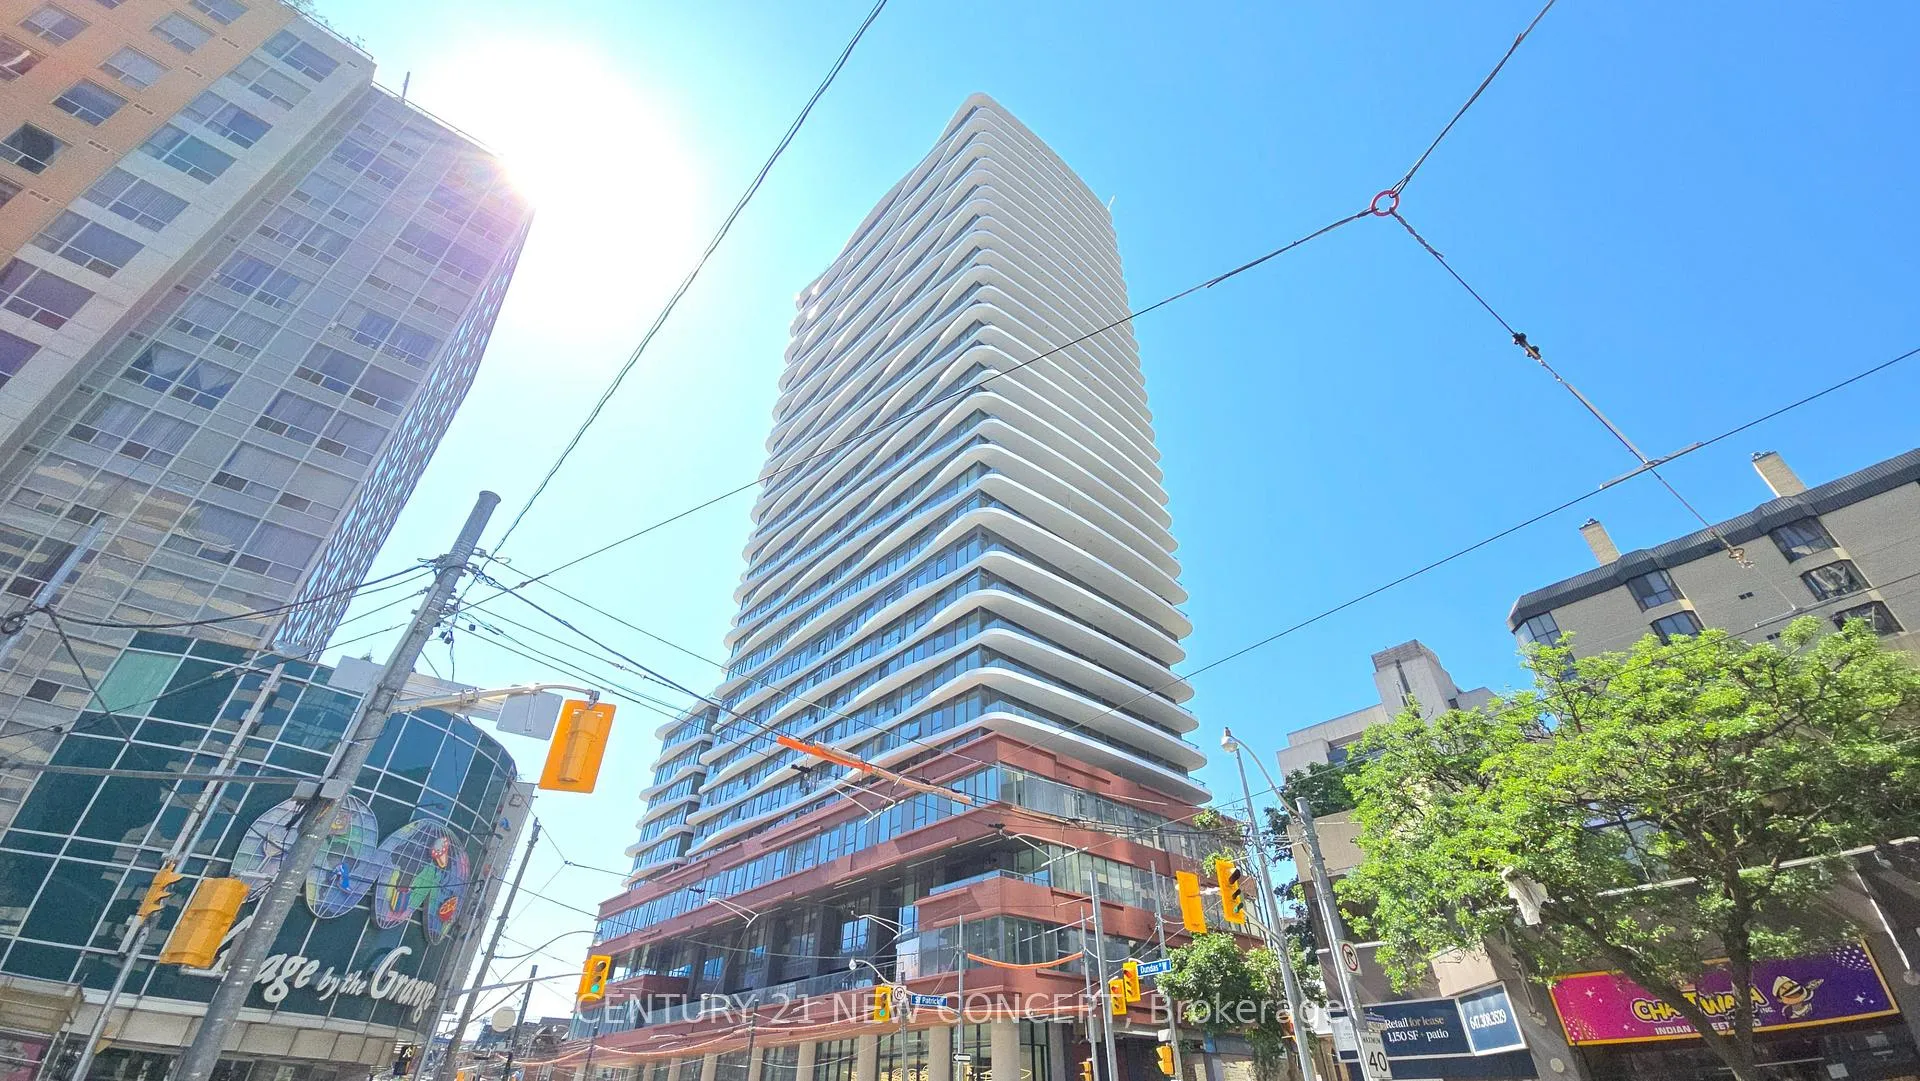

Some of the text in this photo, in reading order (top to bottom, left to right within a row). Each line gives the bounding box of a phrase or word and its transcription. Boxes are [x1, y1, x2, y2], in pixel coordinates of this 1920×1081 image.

[1140, 964, 1158, 973] Dundas
[316, 945, 437, 1023] by the Grange
[922, 996, 940, 1005] Patrick
[1385, 1017, 1408, 1029] Retail
[1409, 1017, 1420, 1027] for
[1421, 1016, 1444, 1026] lease
[1387, 1030, 1408, 1043] 1,150
[1407, 1030, 1419, 1041] SF
[1425, 1028, 1449, 1042] patio
[1655, 1024, 1691, 1035] INDIAN
[1369, 1051, 1387, 1072] 40
